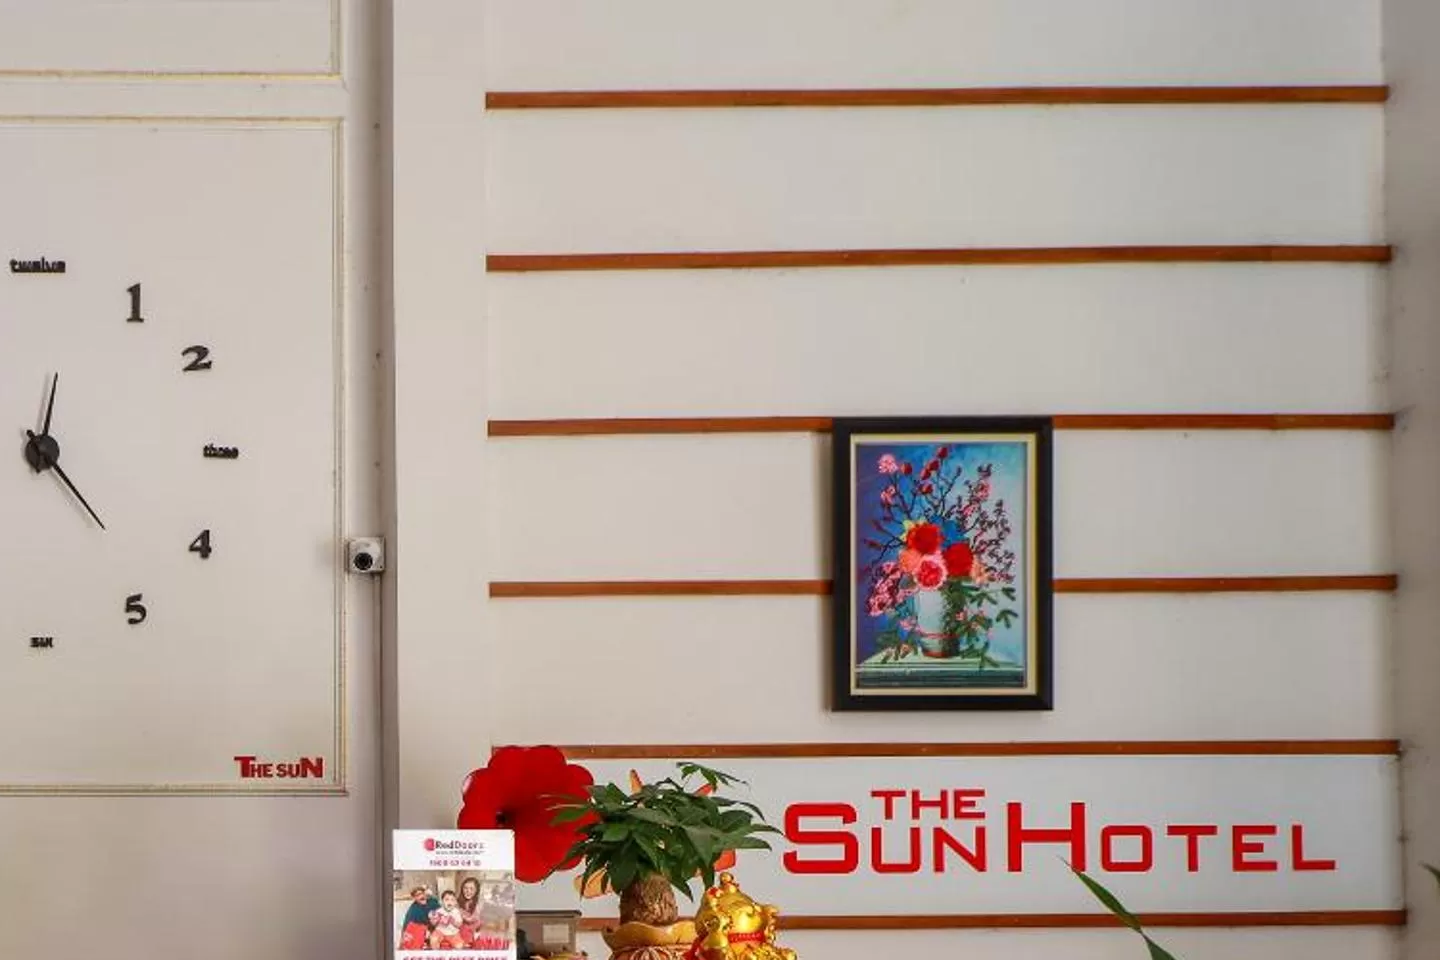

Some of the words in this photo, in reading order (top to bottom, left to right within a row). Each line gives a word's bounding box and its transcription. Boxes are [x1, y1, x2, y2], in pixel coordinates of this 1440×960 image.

[126, 283, 145, 323] 1
[181, 345, 213, 372] 2
[188, 529, 212, 559] 4
[124, 593, 148, 625] 5
[870, 788, 986, 820] THE
[782, 801, 988, 875] SUN
[1006, 801, 1336, 874] HOTEL
